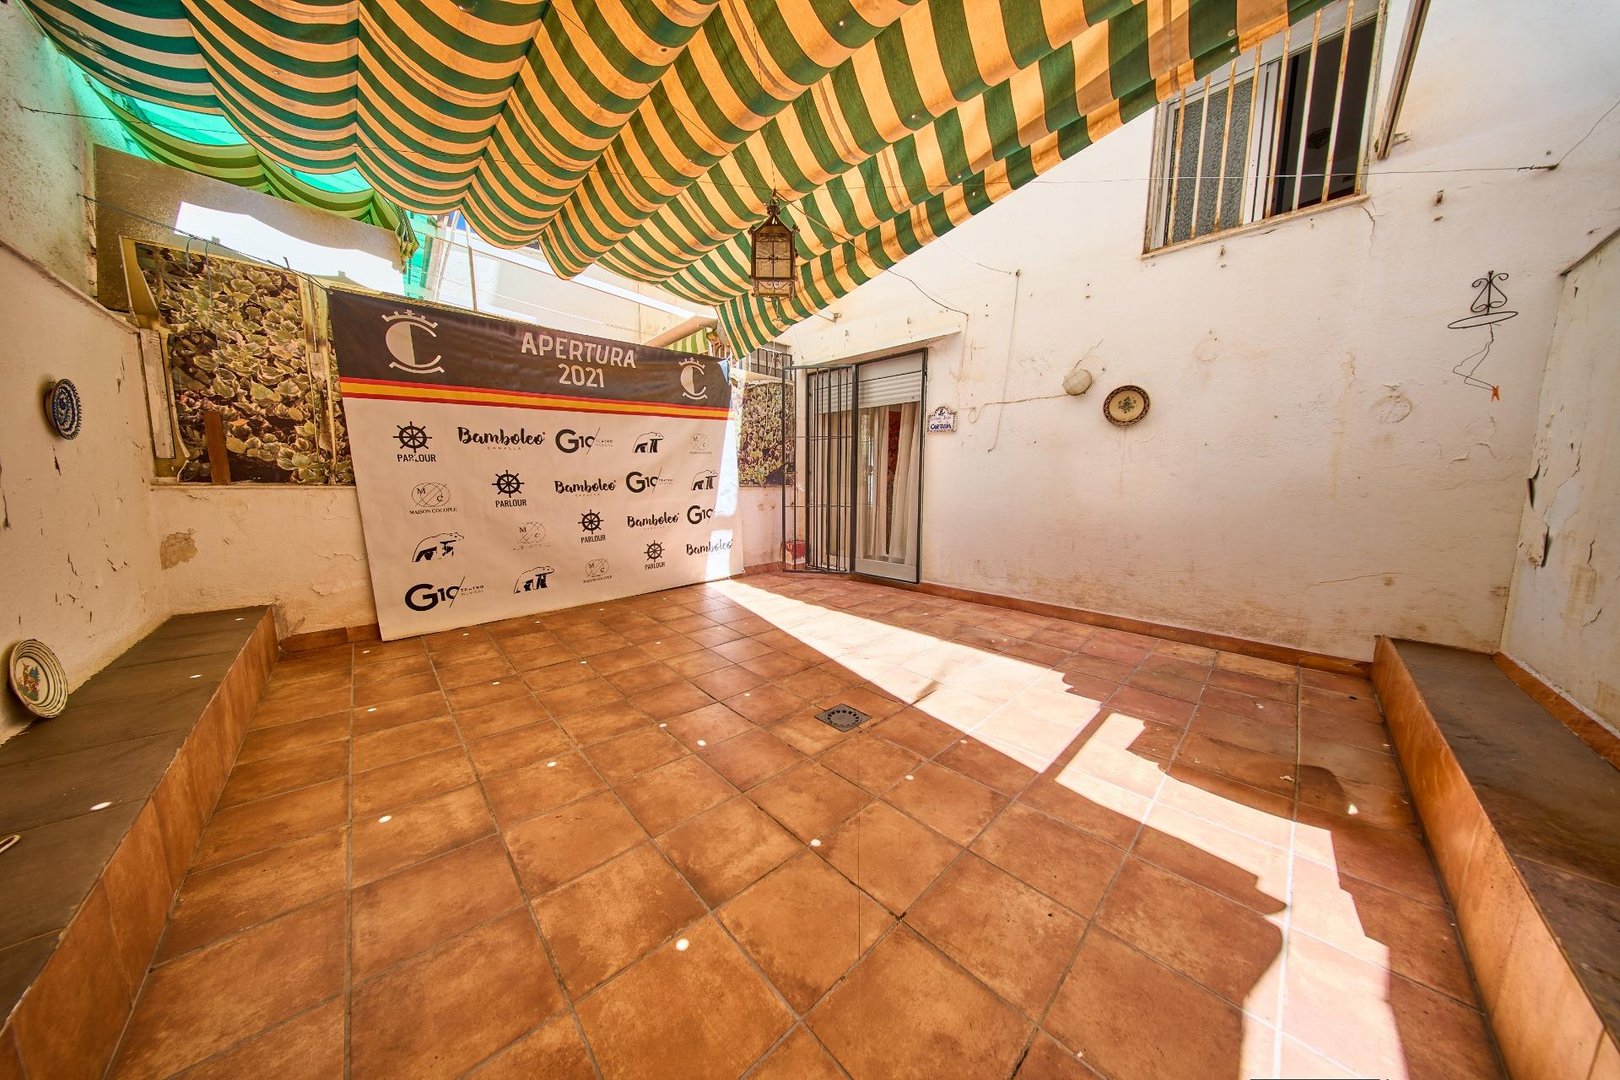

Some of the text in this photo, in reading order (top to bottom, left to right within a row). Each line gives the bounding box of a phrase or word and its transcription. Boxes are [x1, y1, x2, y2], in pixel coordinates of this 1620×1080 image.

[521, 332, 637, 369] APERTURA
[558, 363, 605, 388] 2021
[457, 426, 546, 446] Bamboleo
[396, 453, 437, 463] PARLOUR
[554, 478, 617, 495] Bamboleo
[495, 499, 527, 507] PARLOUR
[627, 511, 680, 528] Bamboleo
[580, 534, 606, 544] PARLOUR
[686, 539, 734, 556] Bamboleo
